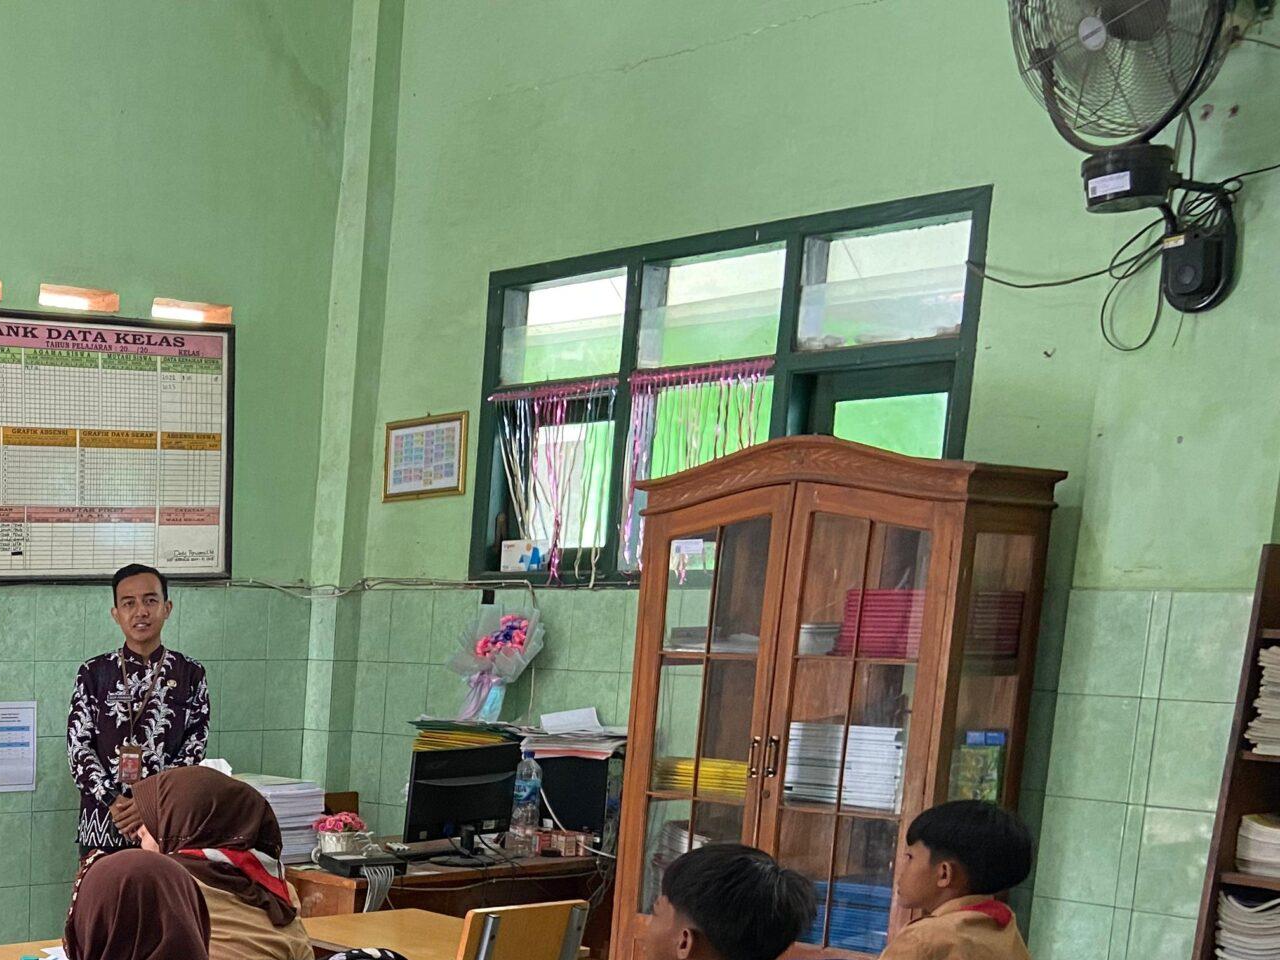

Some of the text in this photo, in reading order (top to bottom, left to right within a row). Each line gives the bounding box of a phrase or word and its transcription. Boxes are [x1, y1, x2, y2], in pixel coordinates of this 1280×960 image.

[46, 327, 108, 343] DATA
[114, 332, 186, 348] KELAS
[45, 341, 70, 349] TAHUN
[72, 342, 113, 352] PELAJARAN
